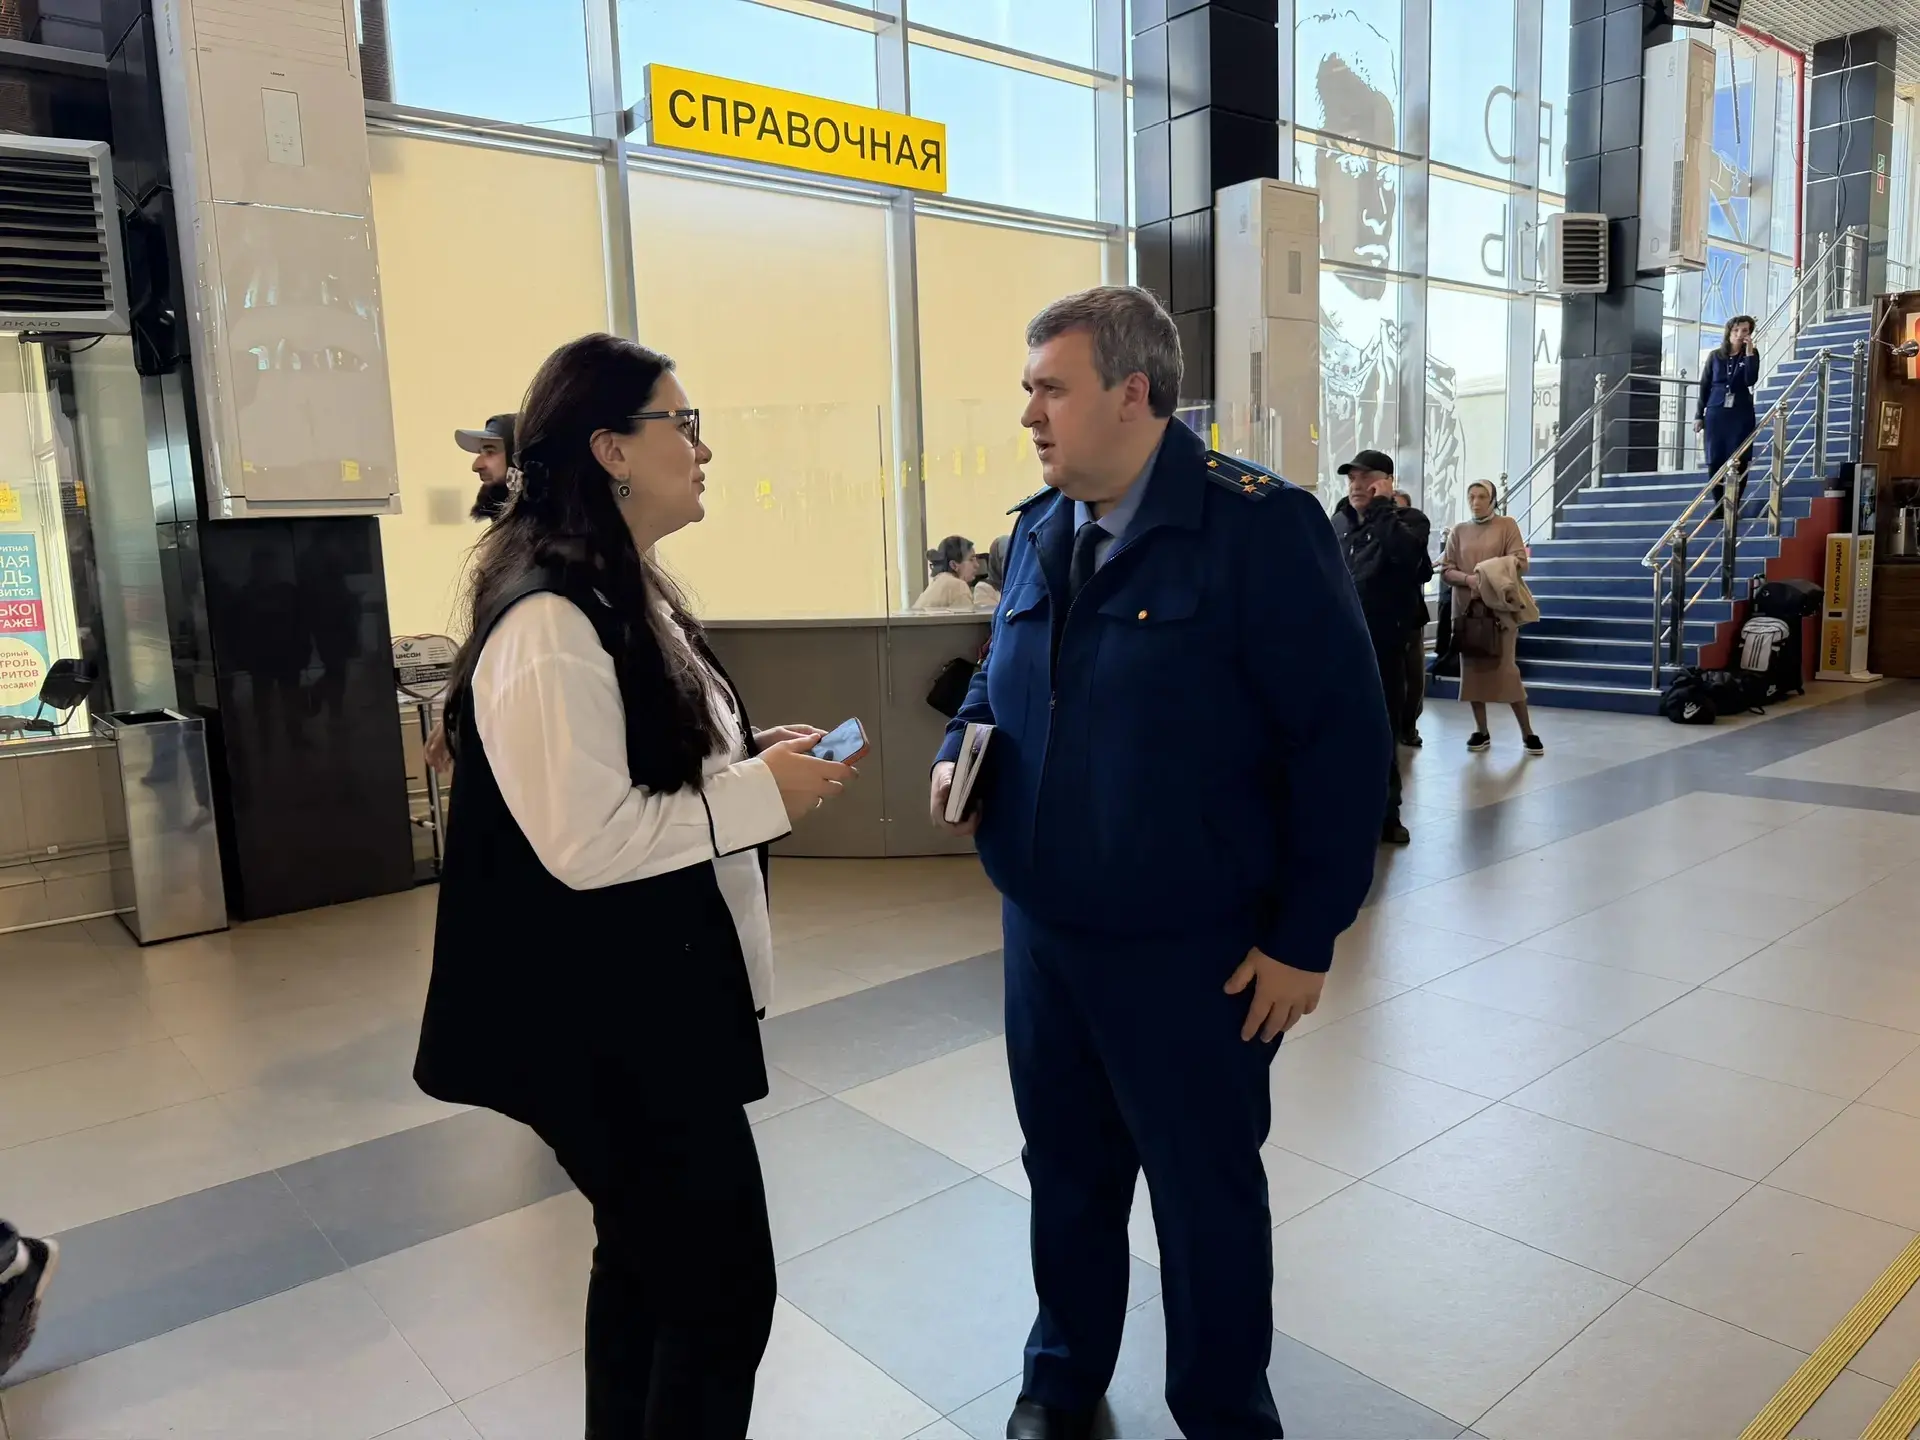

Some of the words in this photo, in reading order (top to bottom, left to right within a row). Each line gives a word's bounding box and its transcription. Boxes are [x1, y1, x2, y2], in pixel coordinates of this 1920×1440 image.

[669, 89, 941, 174] СПРАВОЧНАЯ
[0, 650, 29, 659] орный
[0, 669, 39, 679] РИТОВ
